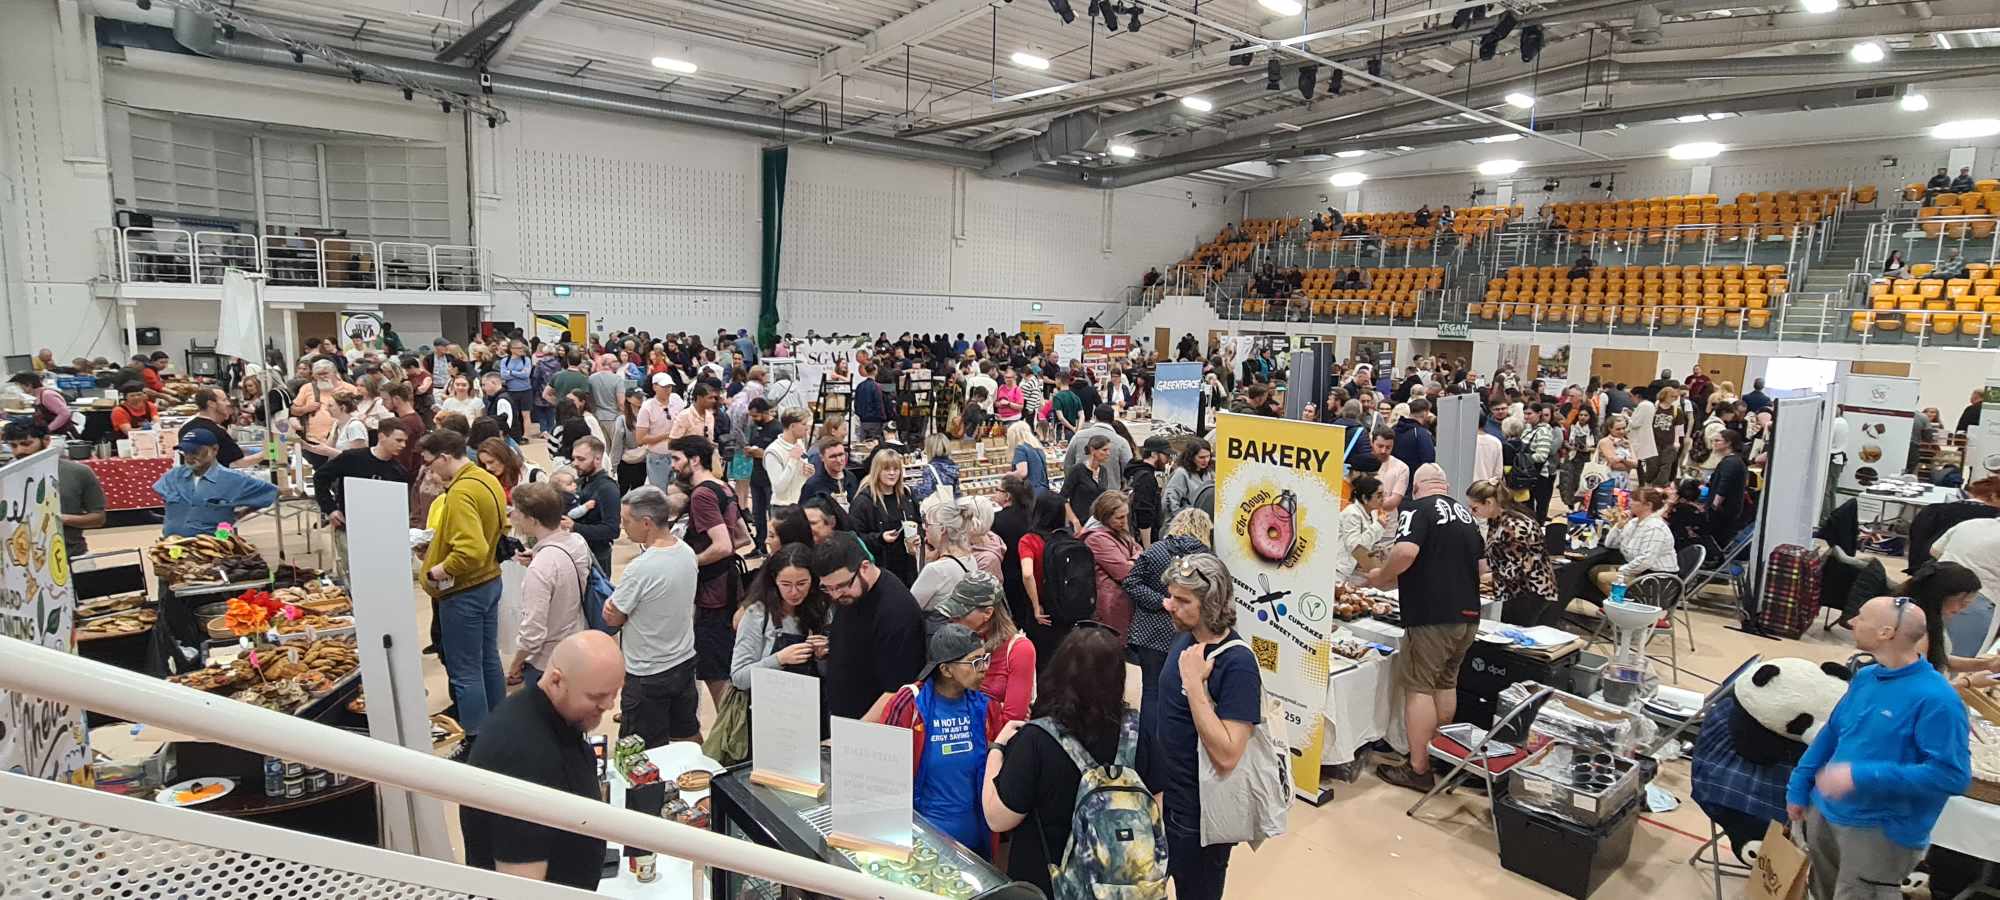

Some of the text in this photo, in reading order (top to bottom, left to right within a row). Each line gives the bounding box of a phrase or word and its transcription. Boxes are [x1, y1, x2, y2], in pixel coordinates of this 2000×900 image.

[1156, 379, 1201, 392] GREENPEACE
[1228, 437, 1330, 473] BAKERY
[1236, 489, 1271, 536] The Dough
[1234, 597, 1256, 613] CAKES
[1288, 614, 1323, 640] CUPCAKES
[1269, 620, 1317, 655] SWEET TREATS
[1487, 663, 1506, 676] dpd
[941, 717, 956, 727] NOT
[1284, 710, 1302, 725] 259
